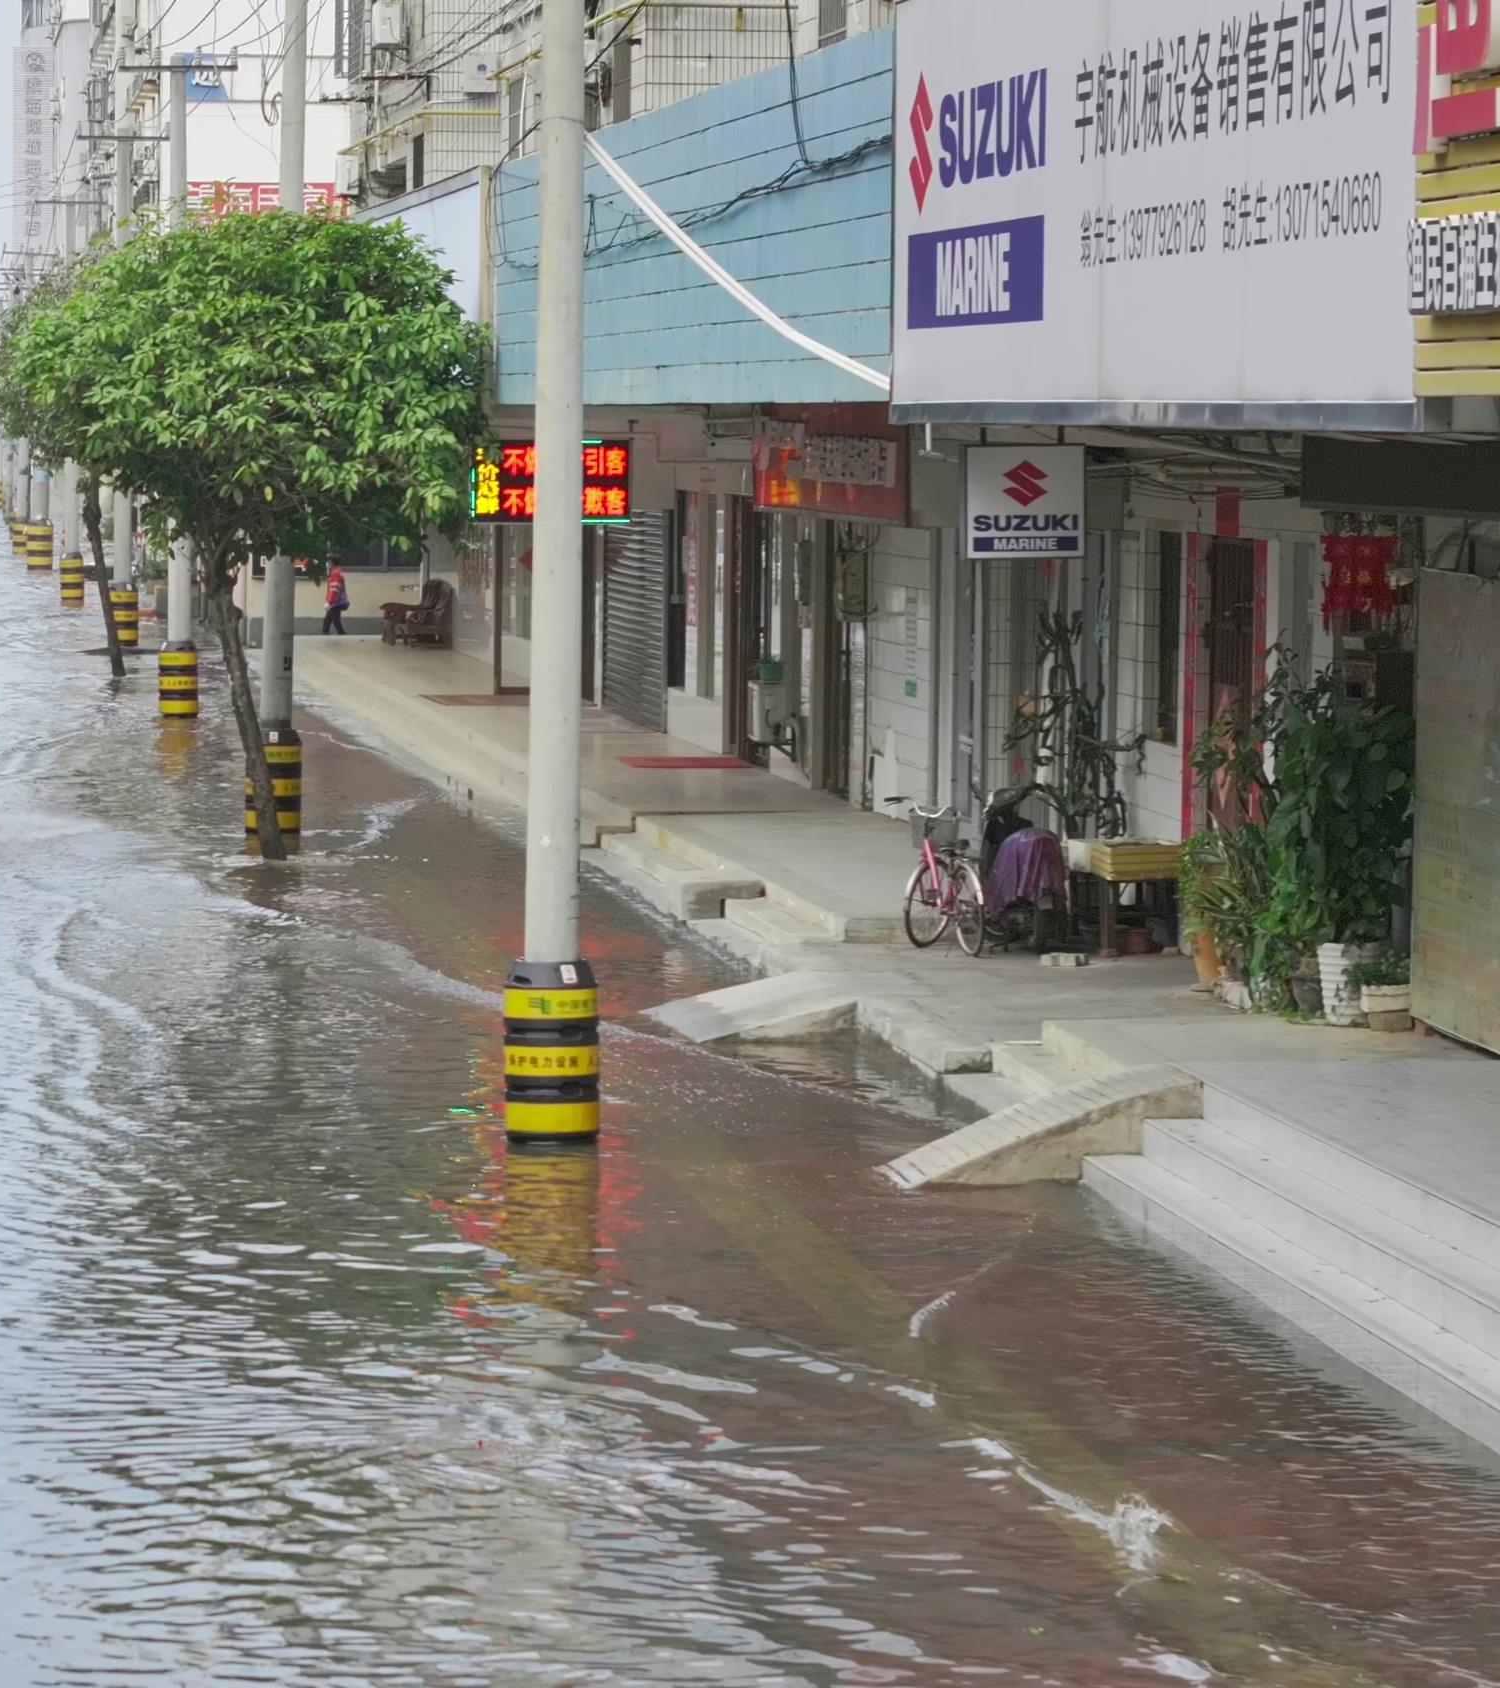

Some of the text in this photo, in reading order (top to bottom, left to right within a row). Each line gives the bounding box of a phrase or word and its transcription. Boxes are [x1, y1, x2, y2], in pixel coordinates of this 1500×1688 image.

[1074, 0, 1392, 164] 宇航机械设备销售有限公司
[938, 68, 1048, 189] SUZUKI
[935, 232, 1010, 317] MARINE
[973, 514, 1078, 532] SUZUKI
[993, 537, 1058, 551] MARINE
